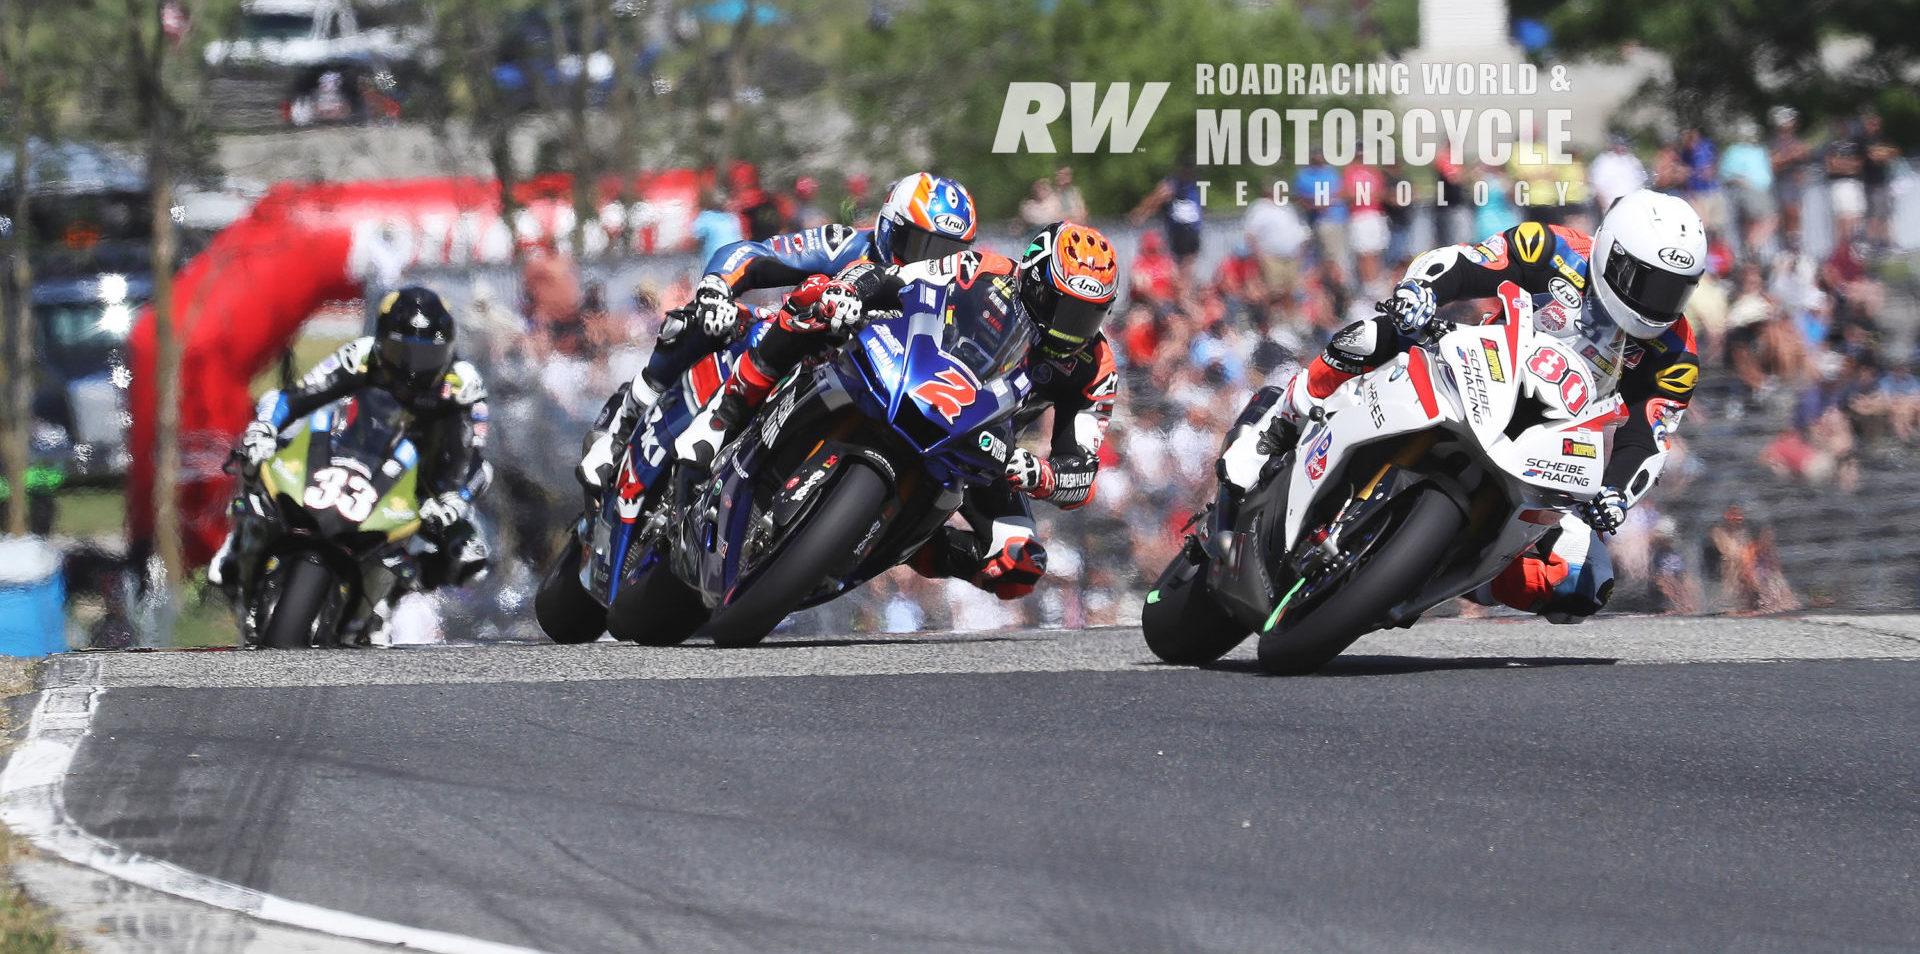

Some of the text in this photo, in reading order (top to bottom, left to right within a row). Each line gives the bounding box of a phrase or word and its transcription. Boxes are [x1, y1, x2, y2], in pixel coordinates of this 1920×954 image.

[936, 215, 963, 231] Arai
[1660, 249, 1691, 265] Arai
[1071, 279, 1100, 294] Arai
[1551, 282, 1579, 306] Arai
[1467, 347, 1492, 418] SCHEIBE
[1526, 347, 1589, 417] 80
[907, 366, 977, 425] 2
[1461, 364, 1484, 426] RACING
[1525, 457, 1586, 475] SCHEIBE
[1541, 471, 1590, 487] RACING
[304, 466, 378, 523] 33
